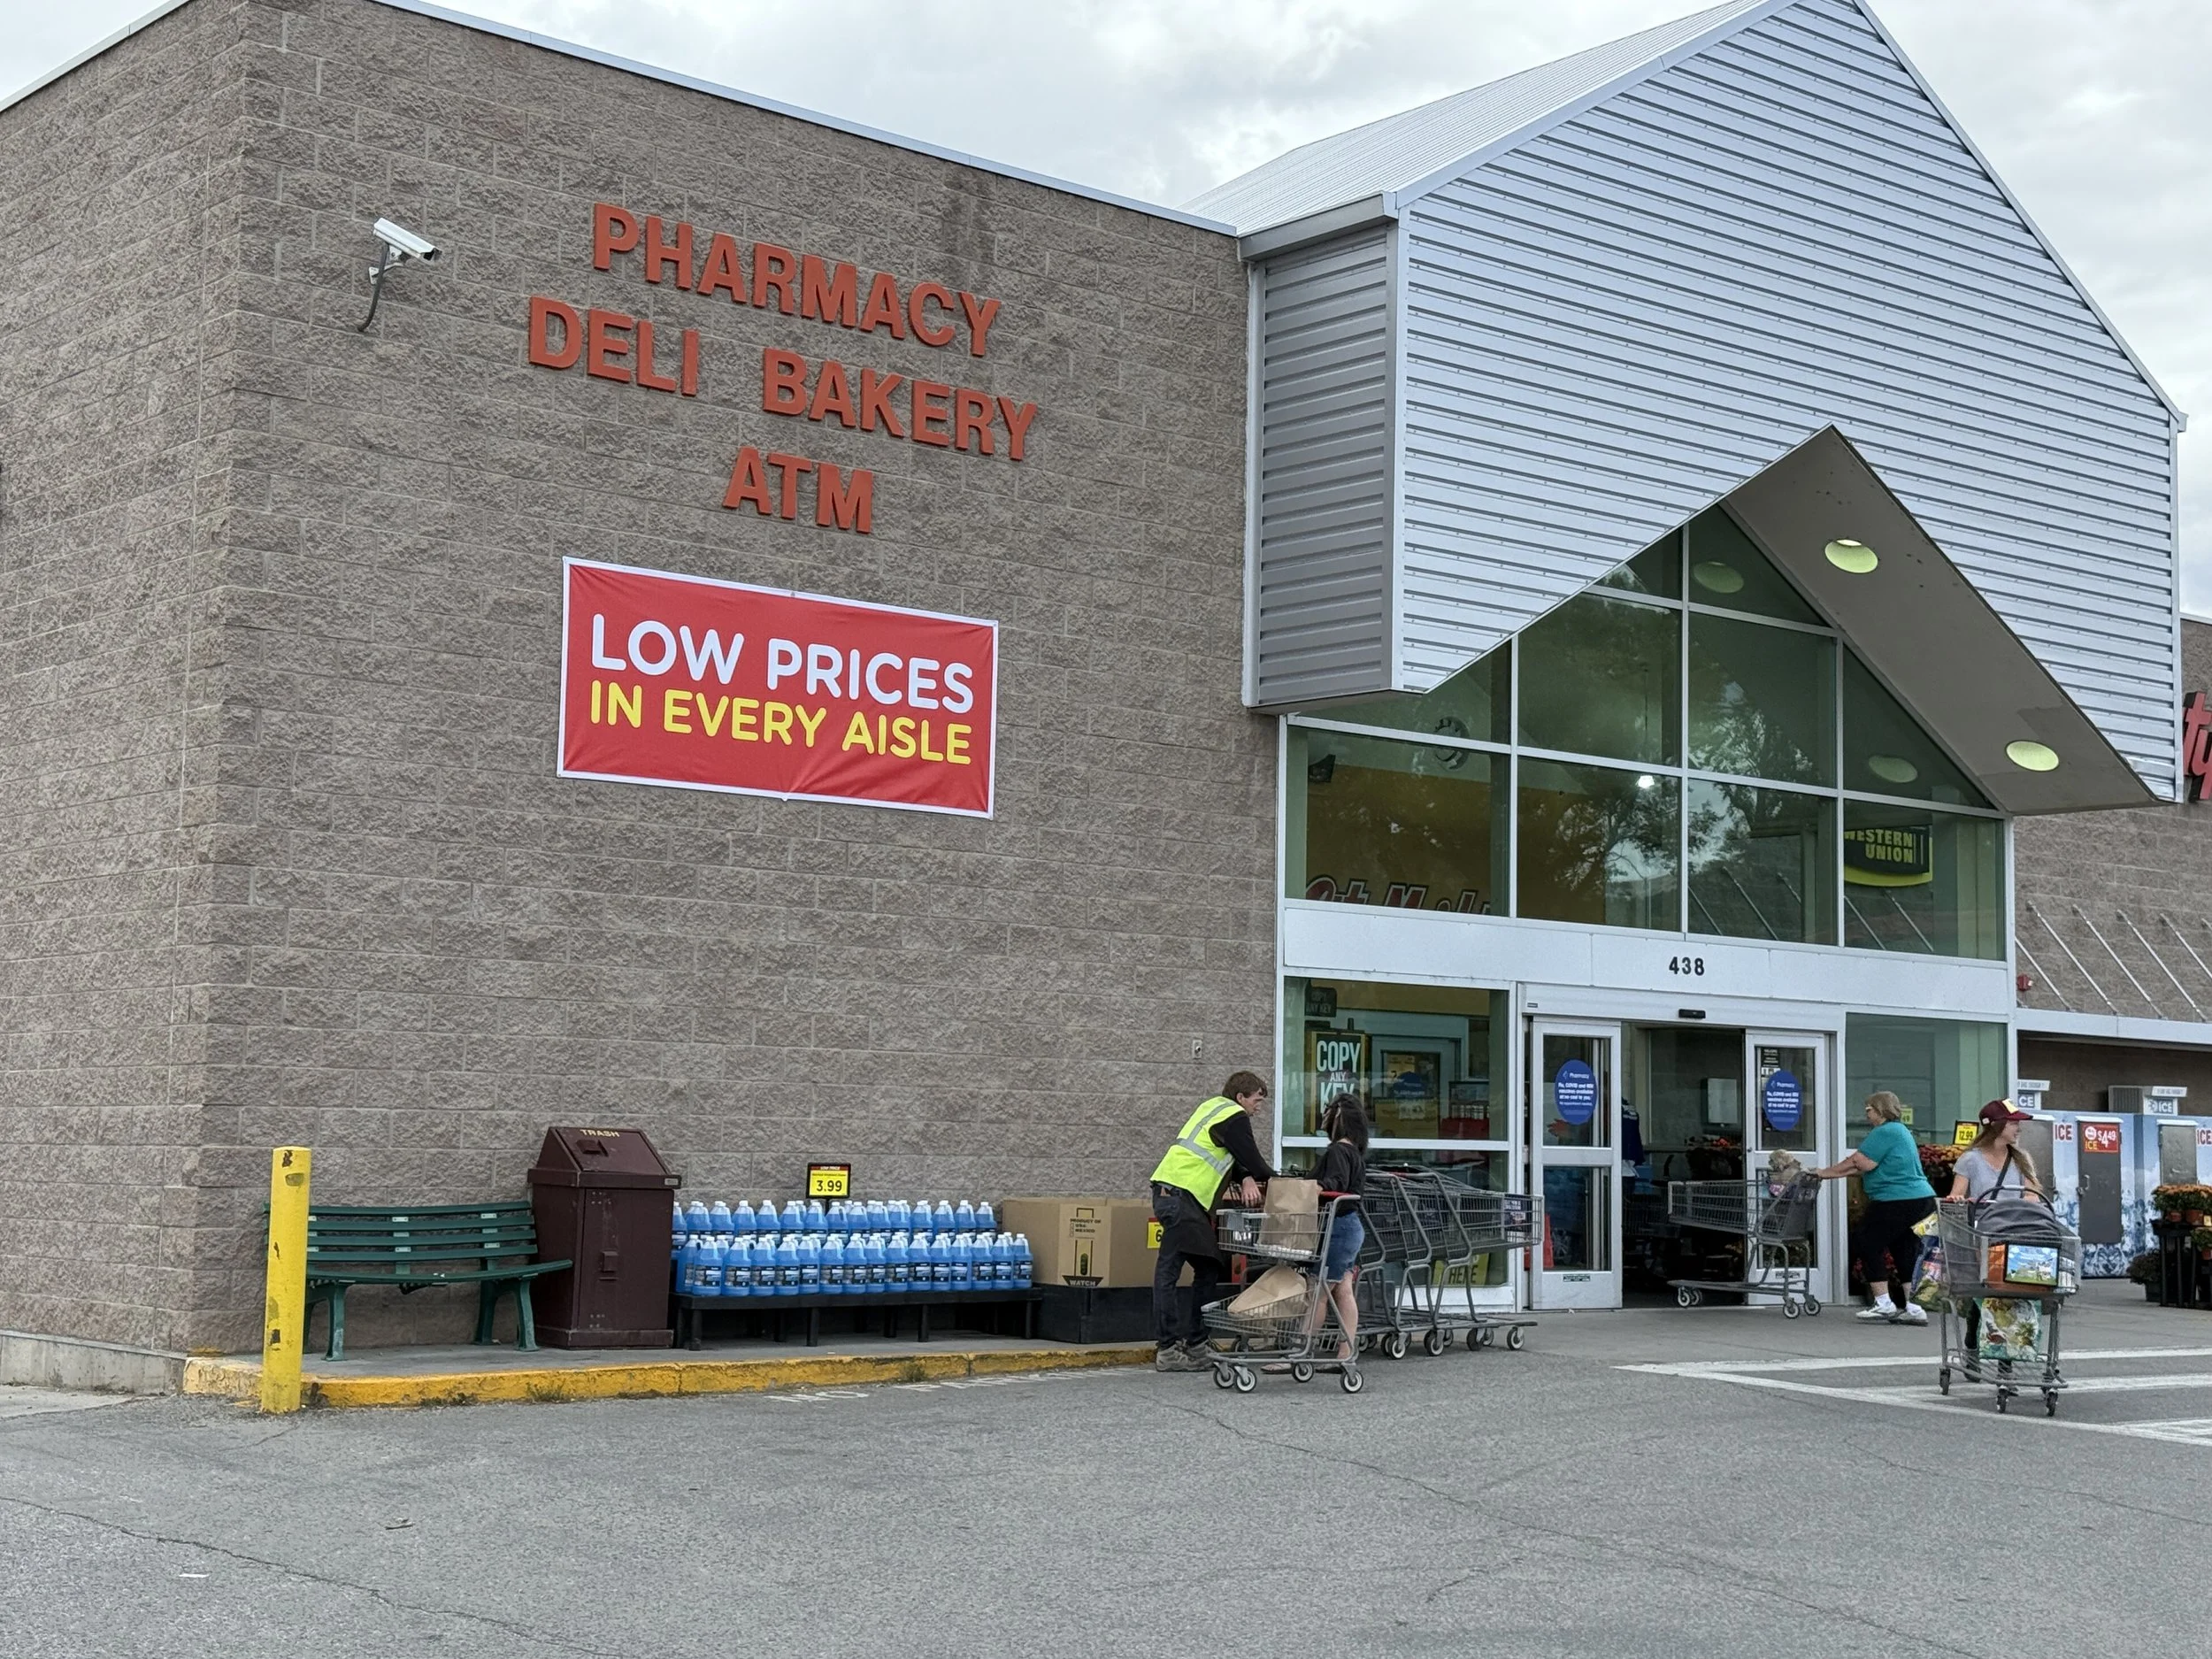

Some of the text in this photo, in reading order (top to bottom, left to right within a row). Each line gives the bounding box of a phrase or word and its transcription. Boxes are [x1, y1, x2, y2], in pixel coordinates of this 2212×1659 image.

[593, 202, 1001, 357] PHARMACY
[528, 296, 1037, 460] DELI BAKERY
[723, 445, 874, 534] ATM
[592, 613, 973, 714] LOW PRICES
[590, 680, 972, 765] IN EVERY AISLE
[1865, 844, 1913, 864] UNION
[1669, 956, 1705, 976] 438
[1317, 1041, 1361, 1073] COPY
[1330, 1071, 1347, 1082] ANY
[2018, 1096, 2034, 1107] CE
[2158, 1101, 2173, 1113] ICE
[580, 1129, 620, 1138] TRASH
[2055, 1124, 2072, 1141] ICE
[2196, 1129, 2212, 1145] ICE
[2085, 1141, 2098, 1150] ICE
[816, 1179, 842, 1192] 3.99
